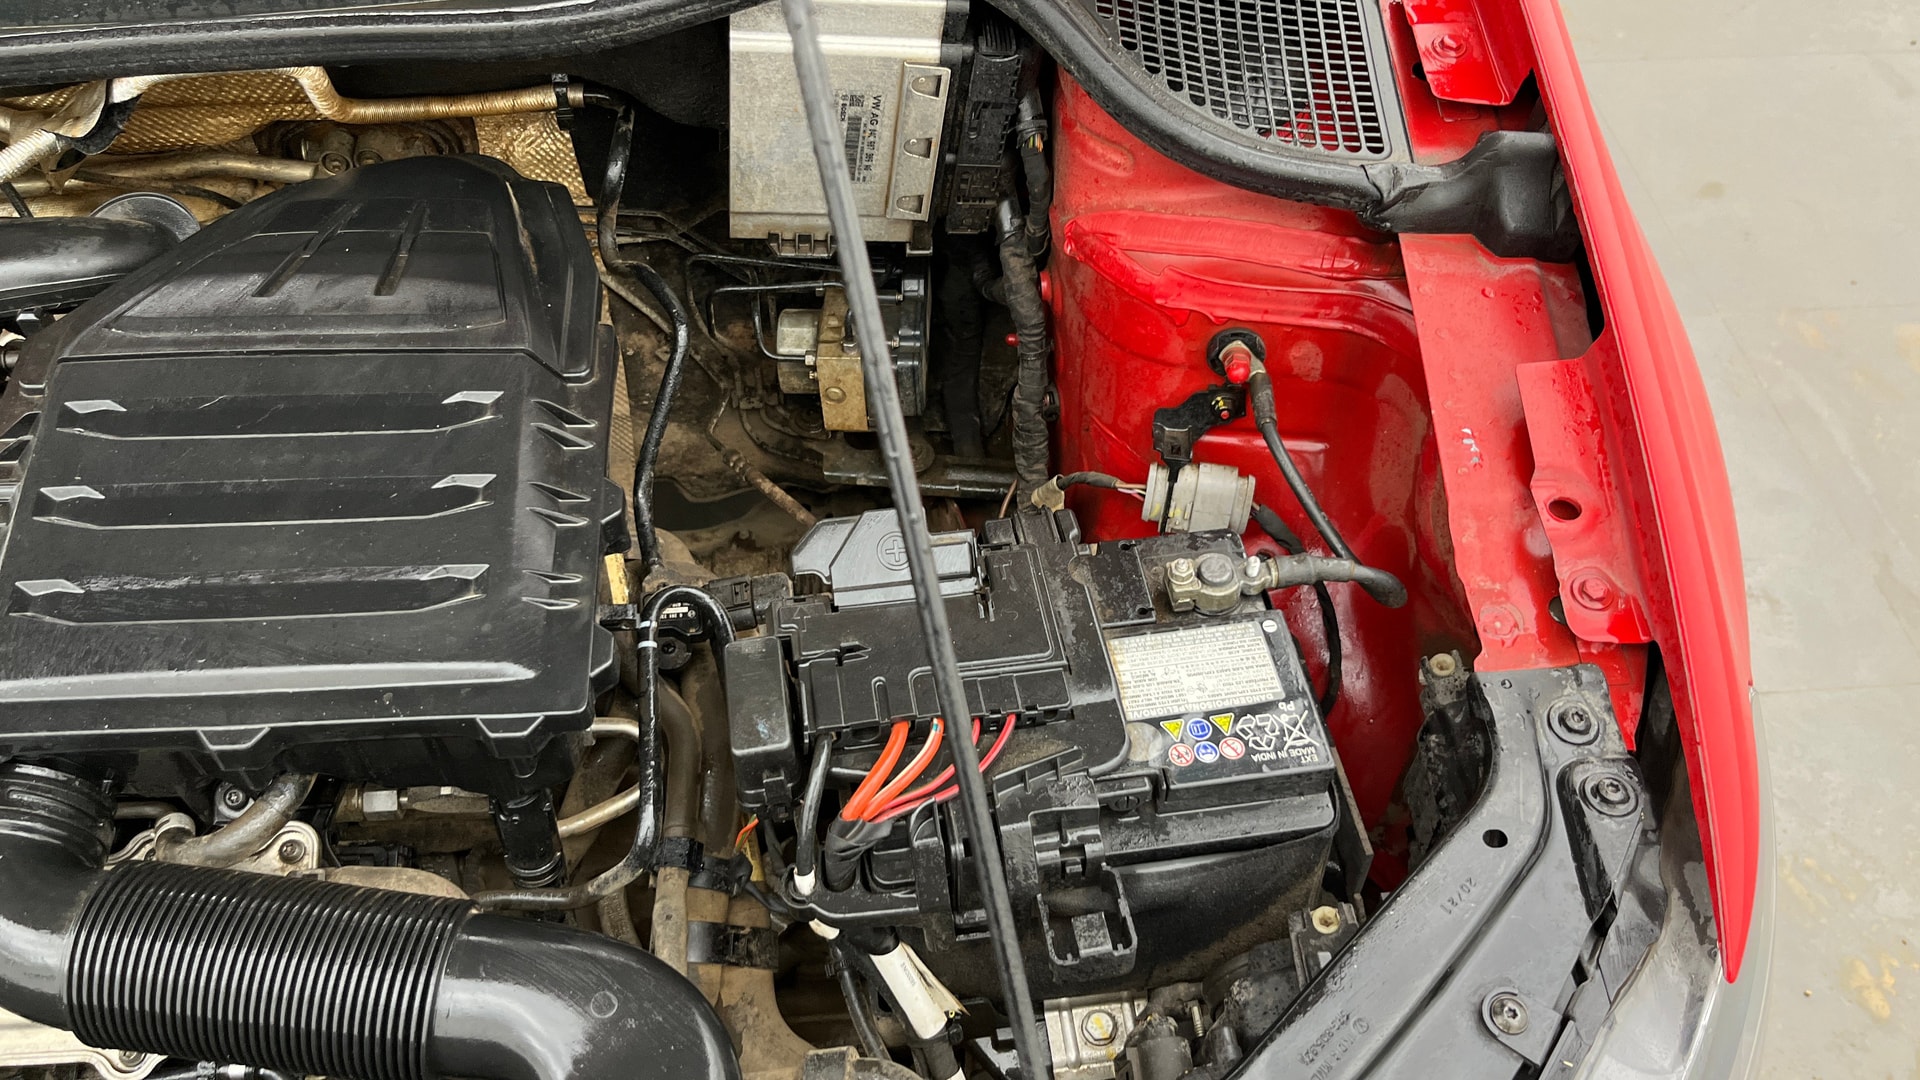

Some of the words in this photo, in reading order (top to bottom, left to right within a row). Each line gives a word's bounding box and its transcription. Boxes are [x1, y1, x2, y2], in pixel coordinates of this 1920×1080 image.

[872, 95, 882, 111] VW
[870, 112, 879, 126] AG
[1278, 701, 1295, 711] Pb
[1251, 751, 1277, 763] INDIA
[1277, 750, 1289, 759] IN
[1288, 746, 1316, 757] MADE
[1301, 754, 1318, 763] EXT
